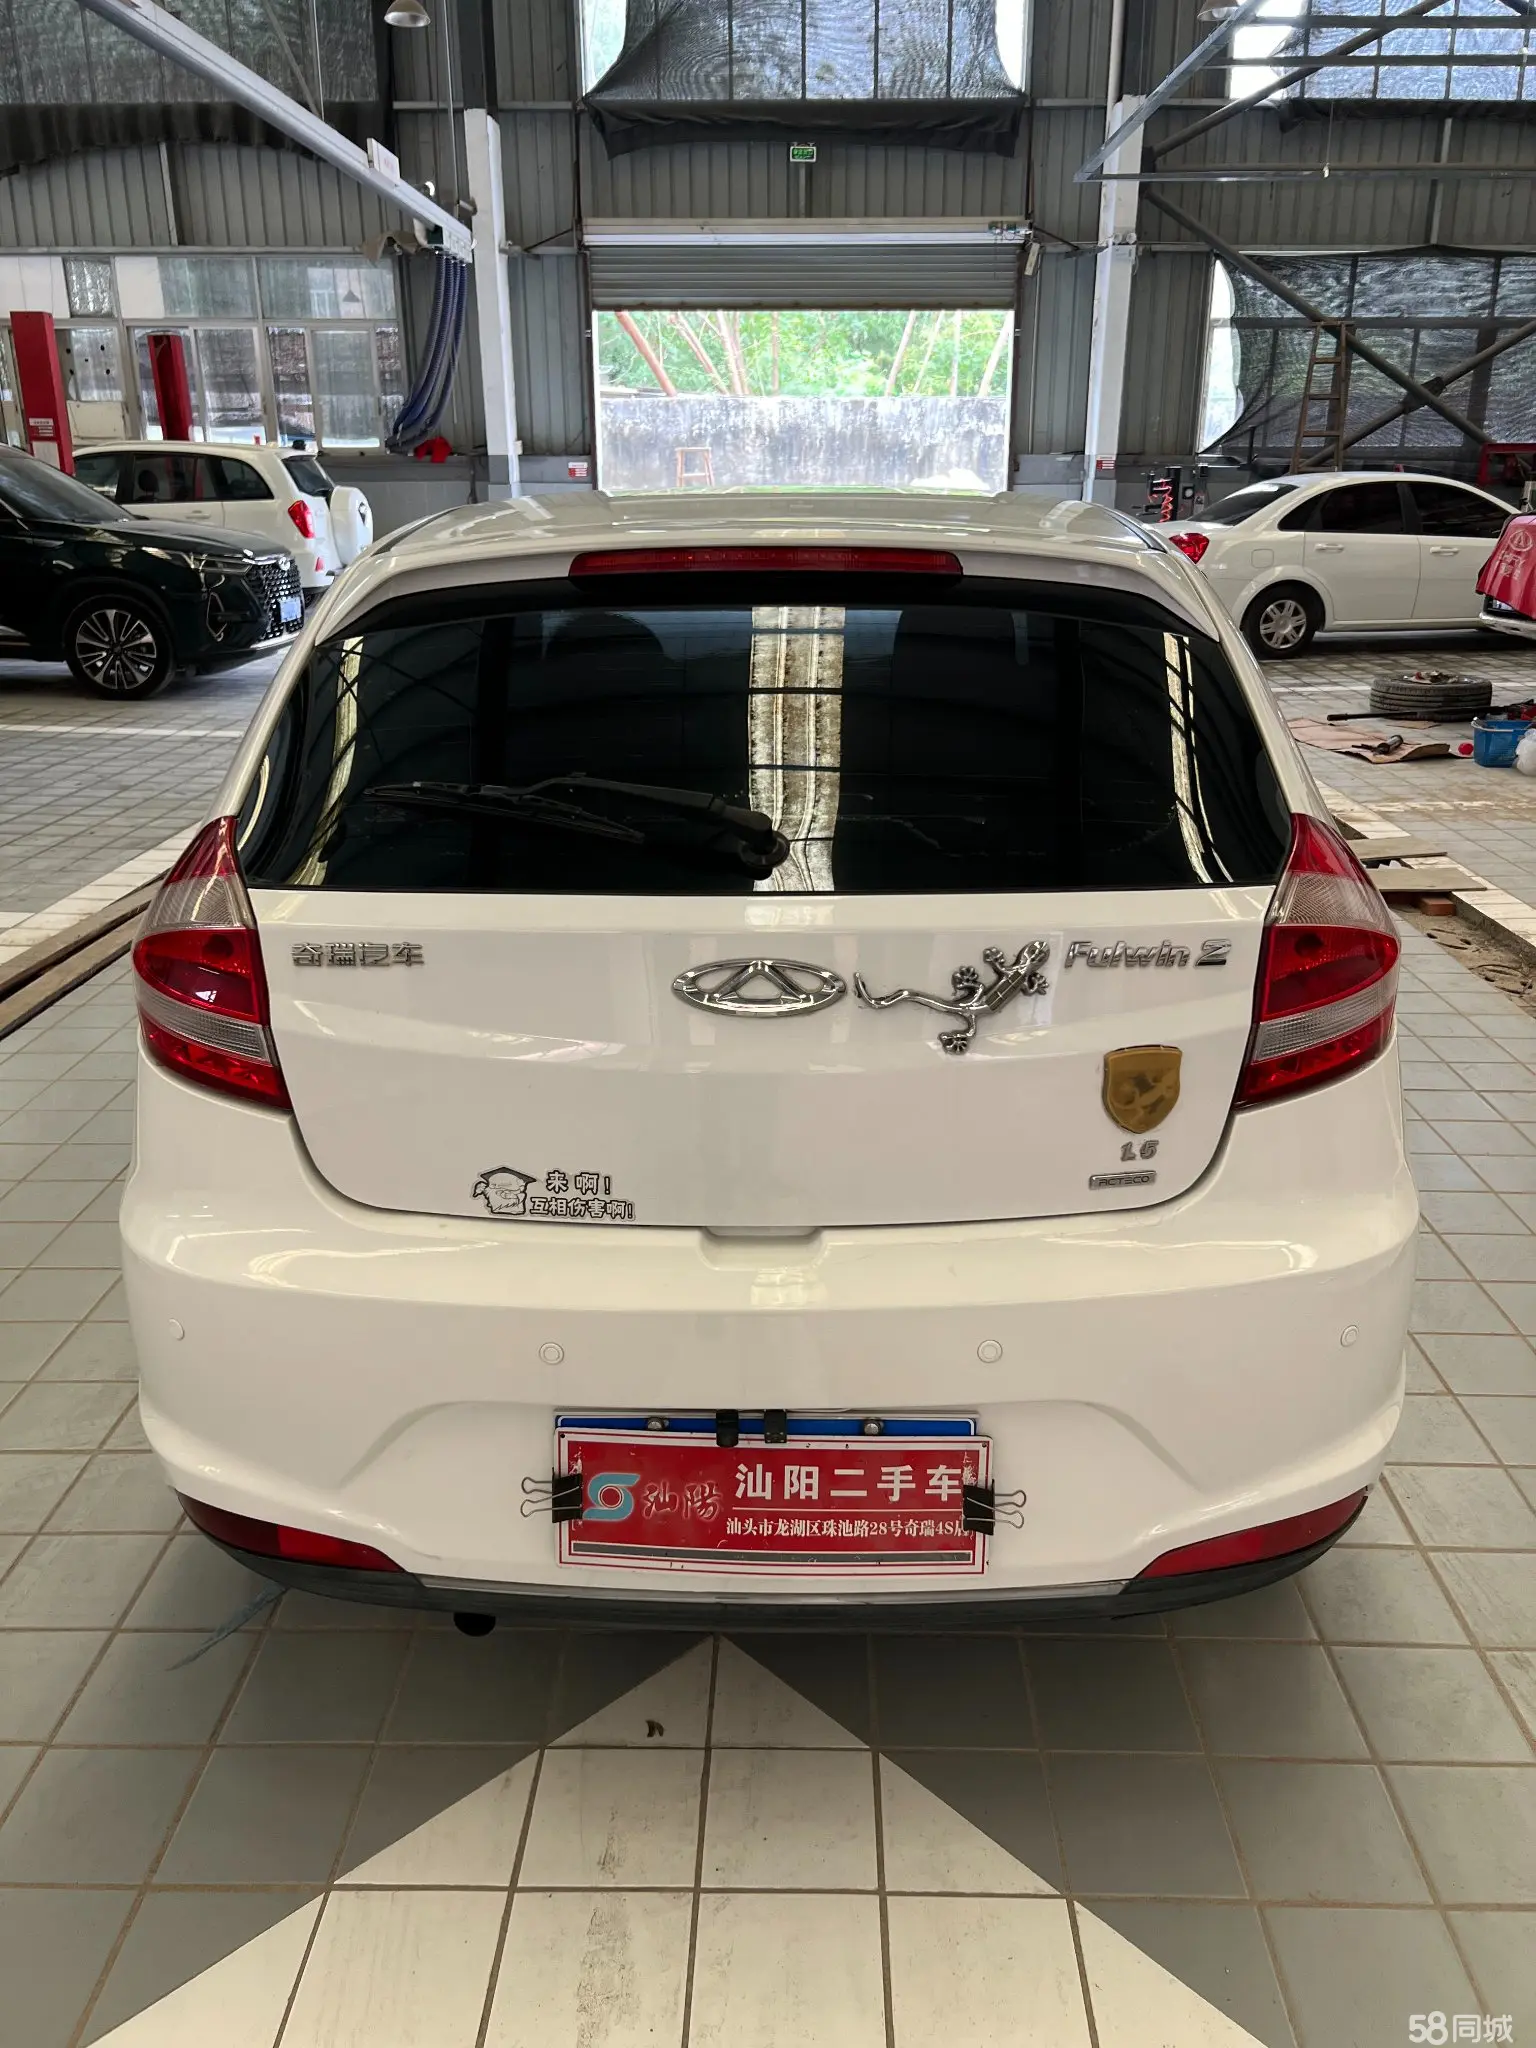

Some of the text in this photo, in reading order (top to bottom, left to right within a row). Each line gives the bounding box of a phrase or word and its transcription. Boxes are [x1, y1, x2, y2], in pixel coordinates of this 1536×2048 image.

[291, 942, 424, 966] 奇瑞汽车
[1064, 939, 1232, 968] Fulwin 2
[1098, 1175, 1150, 1187] ACTECO
[735, 1463, 962, 1502] 汕阳二手车
